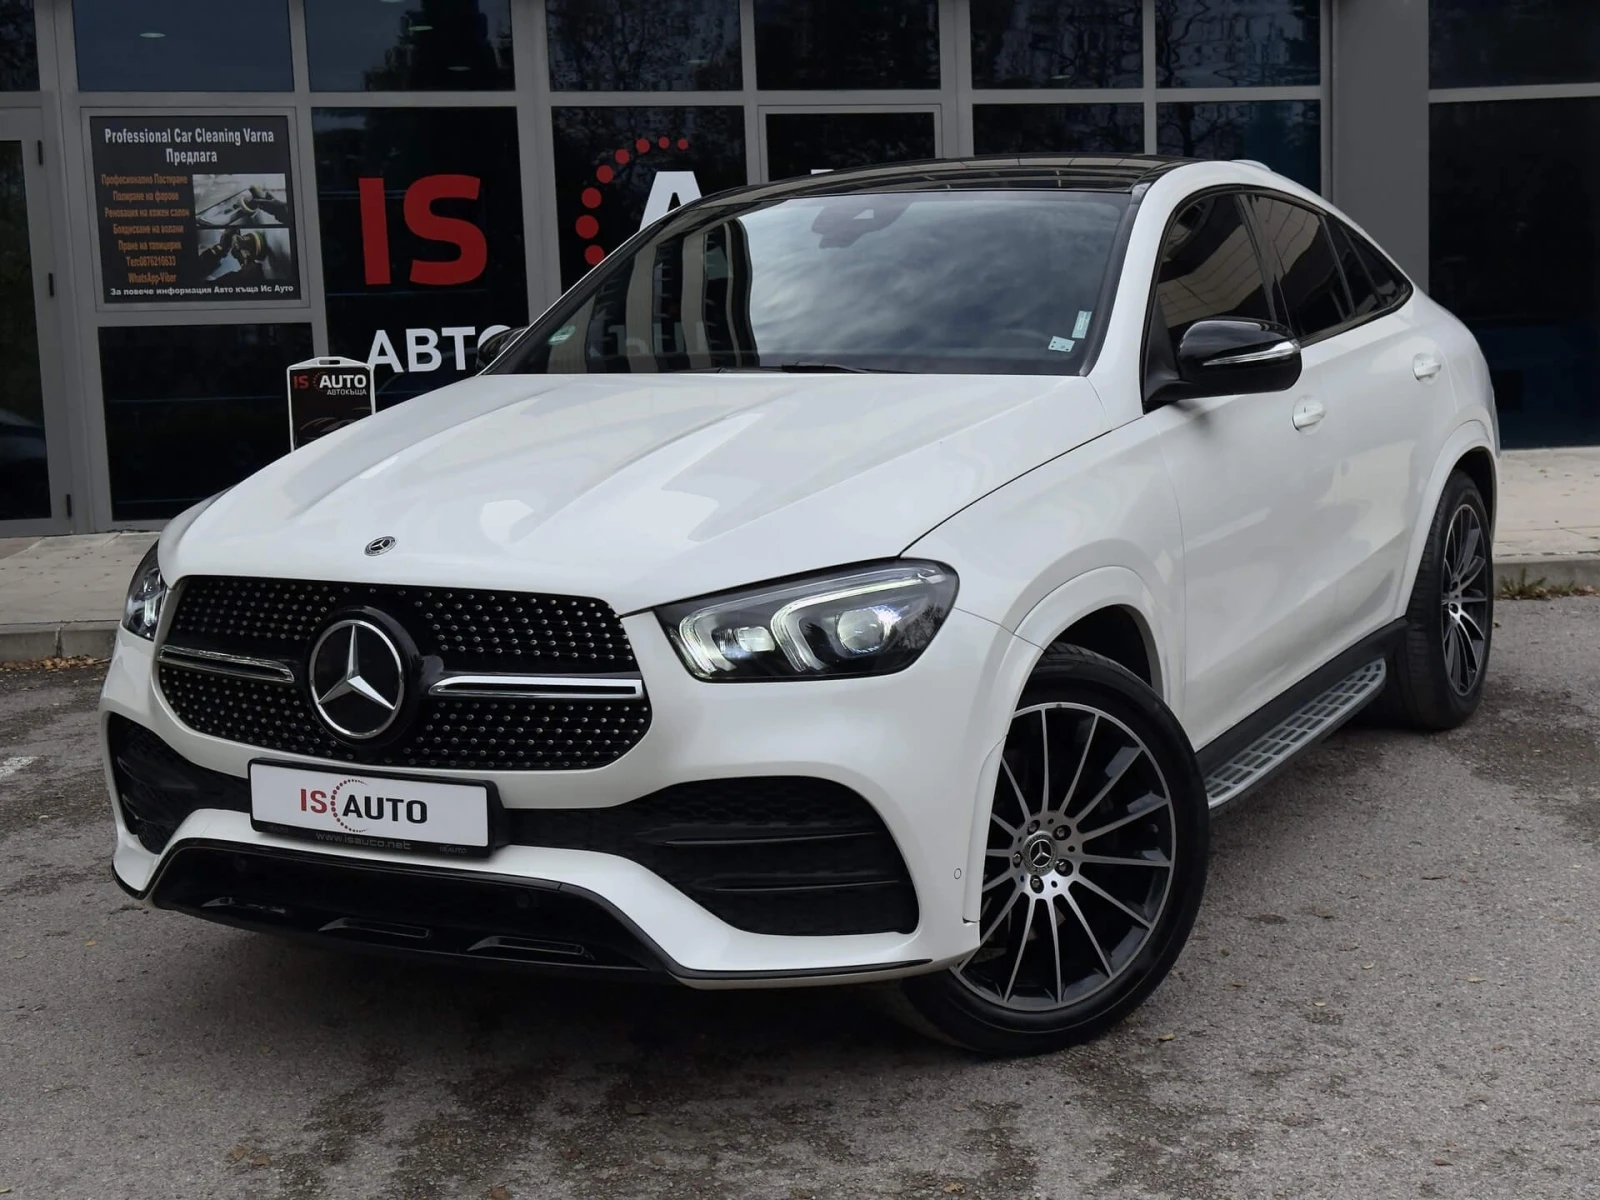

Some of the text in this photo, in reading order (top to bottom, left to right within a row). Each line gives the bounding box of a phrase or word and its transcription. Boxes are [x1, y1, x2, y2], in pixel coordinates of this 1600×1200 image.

[105, 128, 274, 146] Professional Car Cleaning Varna
[166, 148, 218, 166] Предлага
[358, 174, 488, 285] IS
[110, 285, 294, 297] За повече информация Авто къща Ис Ауто
[293, 374, 367, 389] IS AUTO
[326, 388, 367, 396] АВТОКЪЩА
[300, 789, 428, 824] IS AUTO
